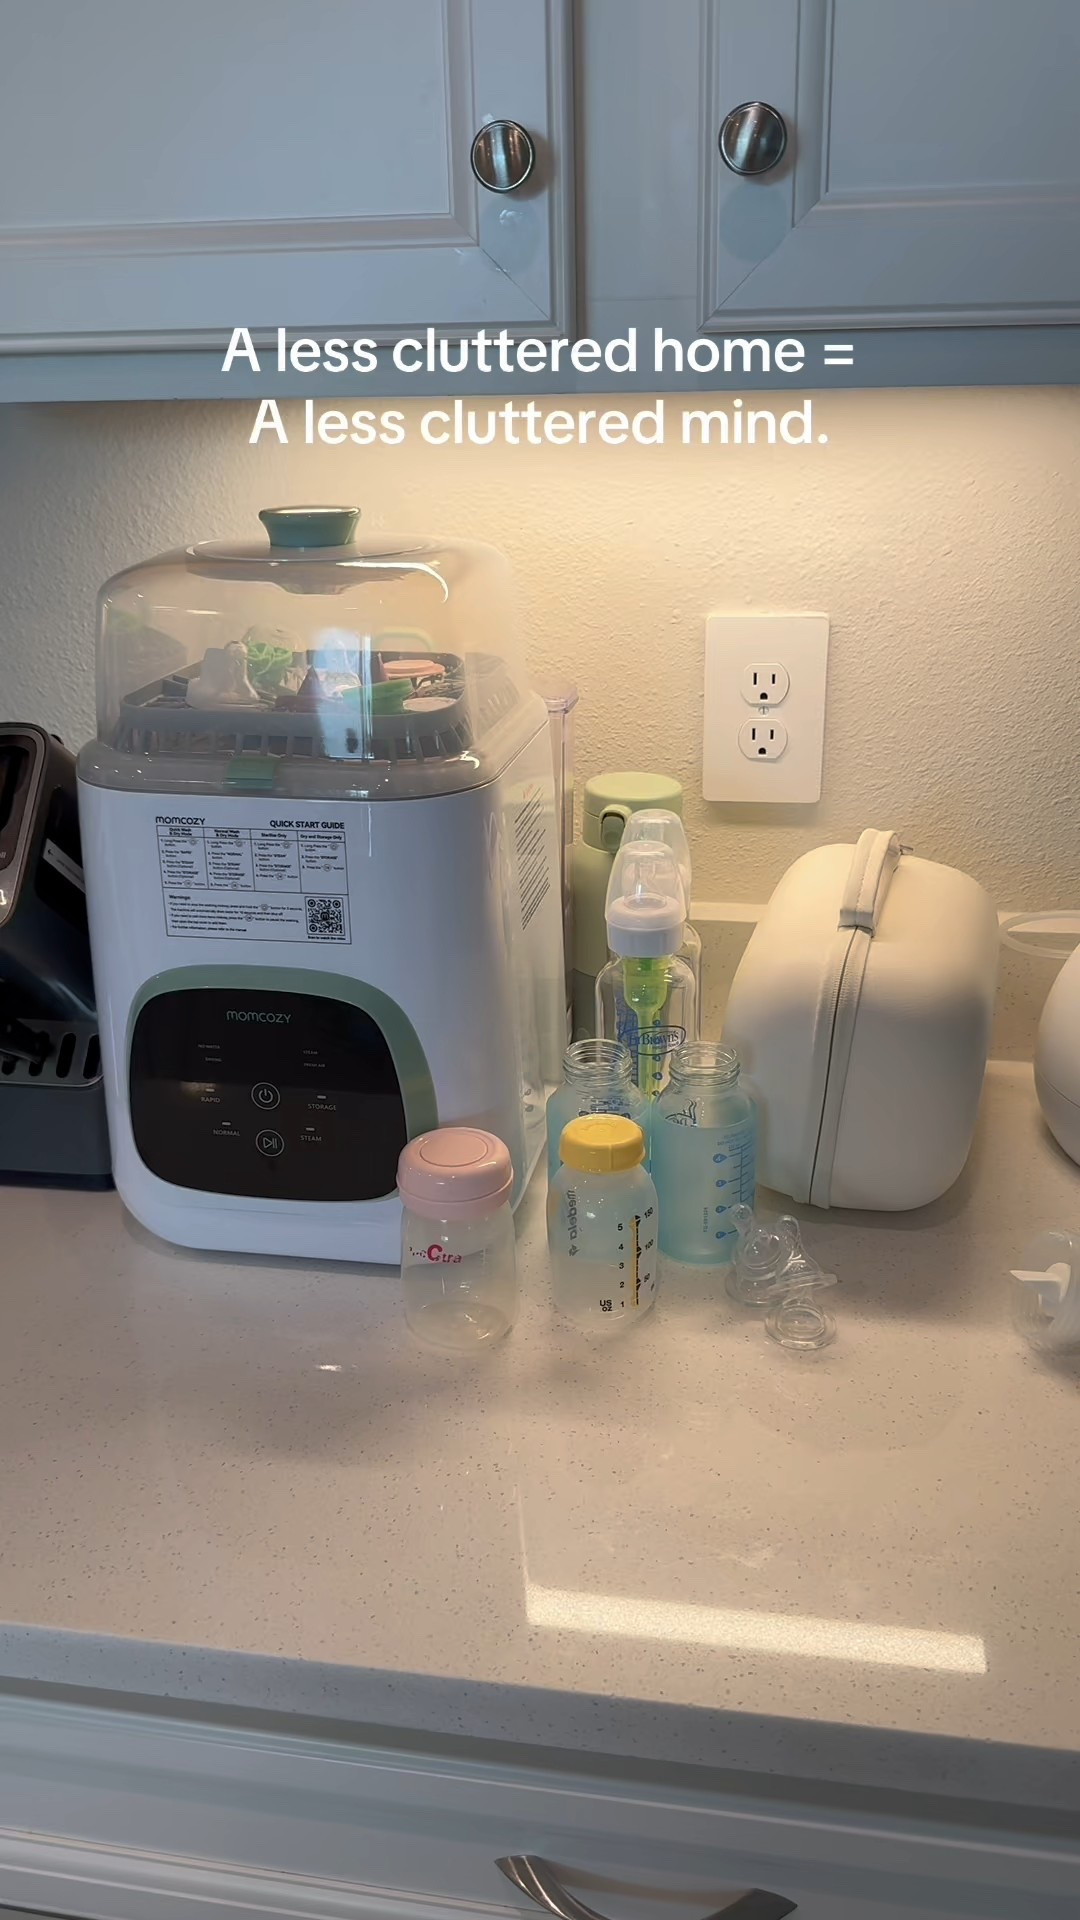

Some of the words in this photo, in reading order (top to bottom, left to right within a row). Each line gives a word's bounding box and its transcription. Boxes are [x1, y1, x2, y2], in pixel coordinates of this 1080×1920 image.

[270, 820, 294, 828] QUICK
[201, 1096, 221, 1104] RAPID
[308, 1103, 336, 1111] STORAGE
[644, 1207, 654, 1219] 150
[617, 1223, 623, 1231] 5
[645, 1239, 654, 1250] 100
[619, 1262, 624, 1270] 3
[599, 1299, 612, 1307] US
